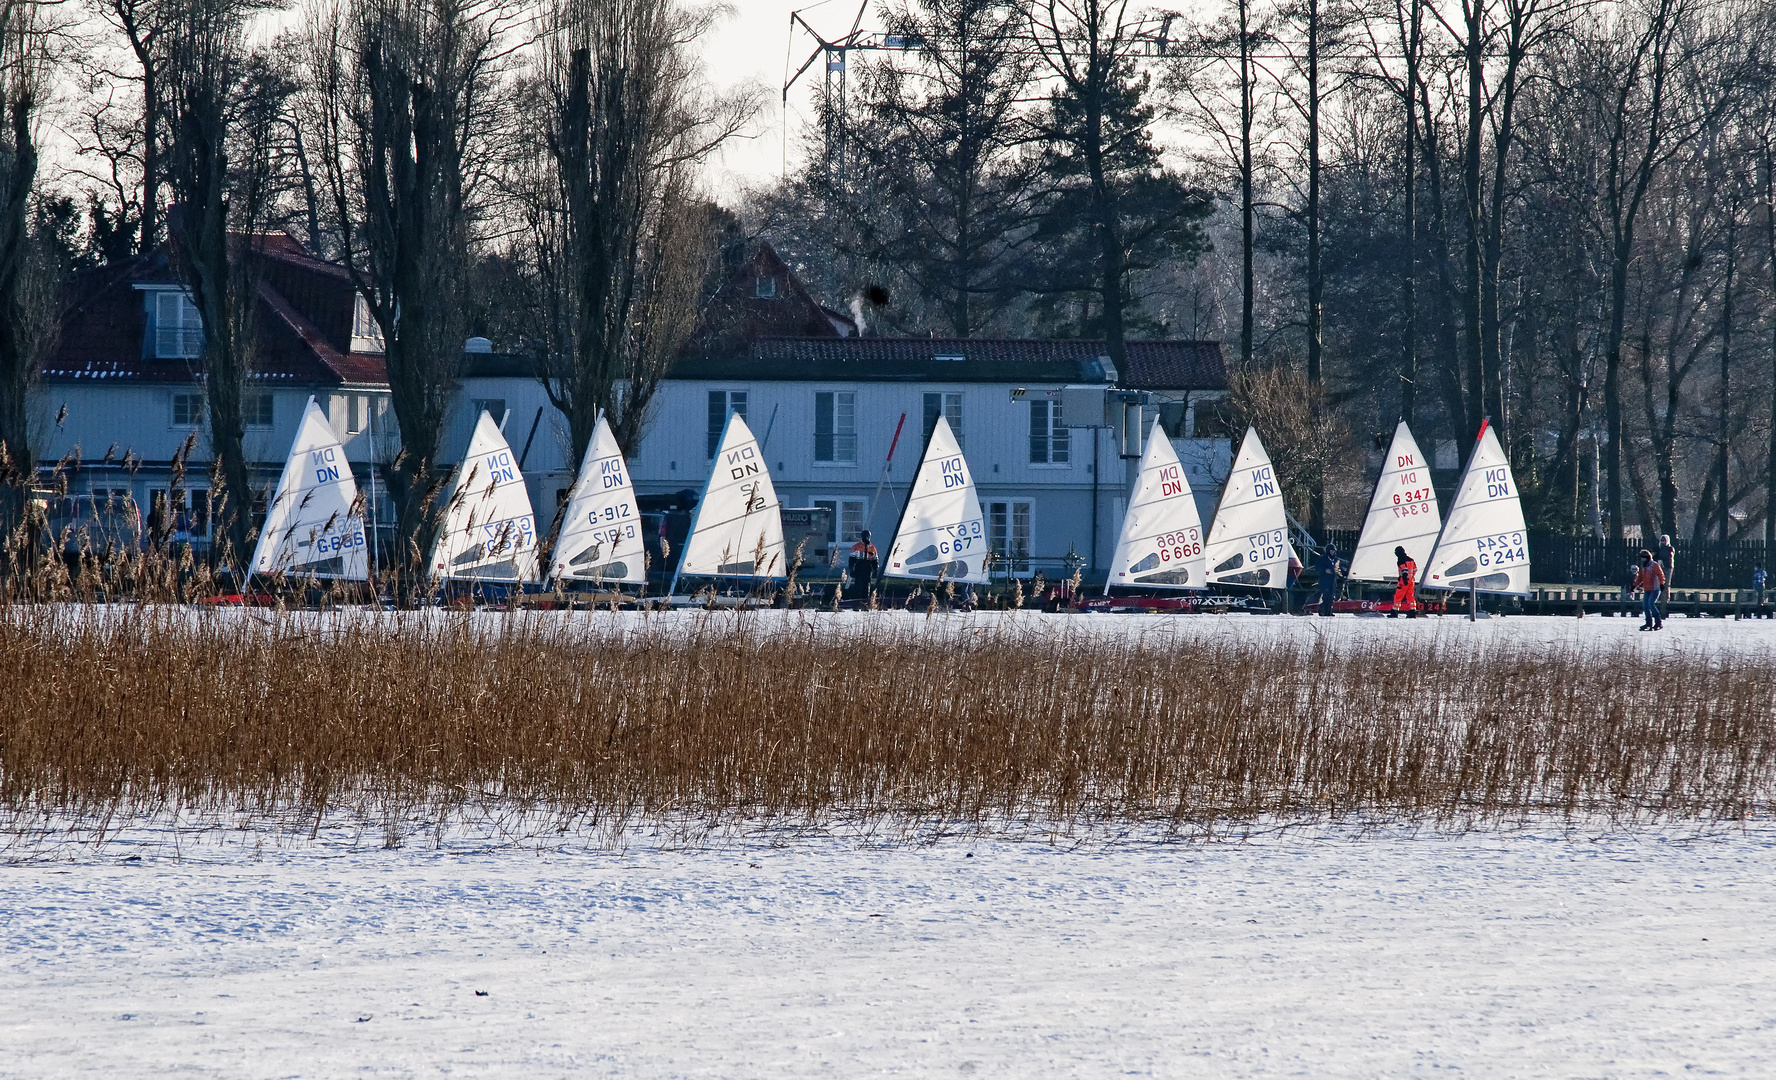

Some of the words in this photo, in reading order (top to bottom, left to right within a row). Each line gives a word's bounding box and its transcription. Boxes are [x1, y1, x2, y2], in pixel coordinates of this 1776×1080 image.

[1397, 454, 1414, 468] DN
[316, 465, 340, 483] DN
[491, 467, 514, 484] DN
[731, 462, 759, 480] DN
[603, 473, 623, 489] DN
[944, 472, 965, 488] DN
[1162, 480, 1182, 496] DN
[1254, 481, 1274, 497] DN
[1393, 494, 1401, 505] G
[1405, 488, 1430, 503] 347
[1487, 482, 1509, 498] DN
[588, 503, 631, 525] G-912
[940, 541, 950, 554] G
[1161, 549, 1170, 562] G
[1173, 542, 1201, 559] 666
[1249, 550, 1258, 563] G
[1262, 544, 1284, 560] 107
[1479, 553, 1489, 567] G
[1493, 547, 1525, 565] 244
